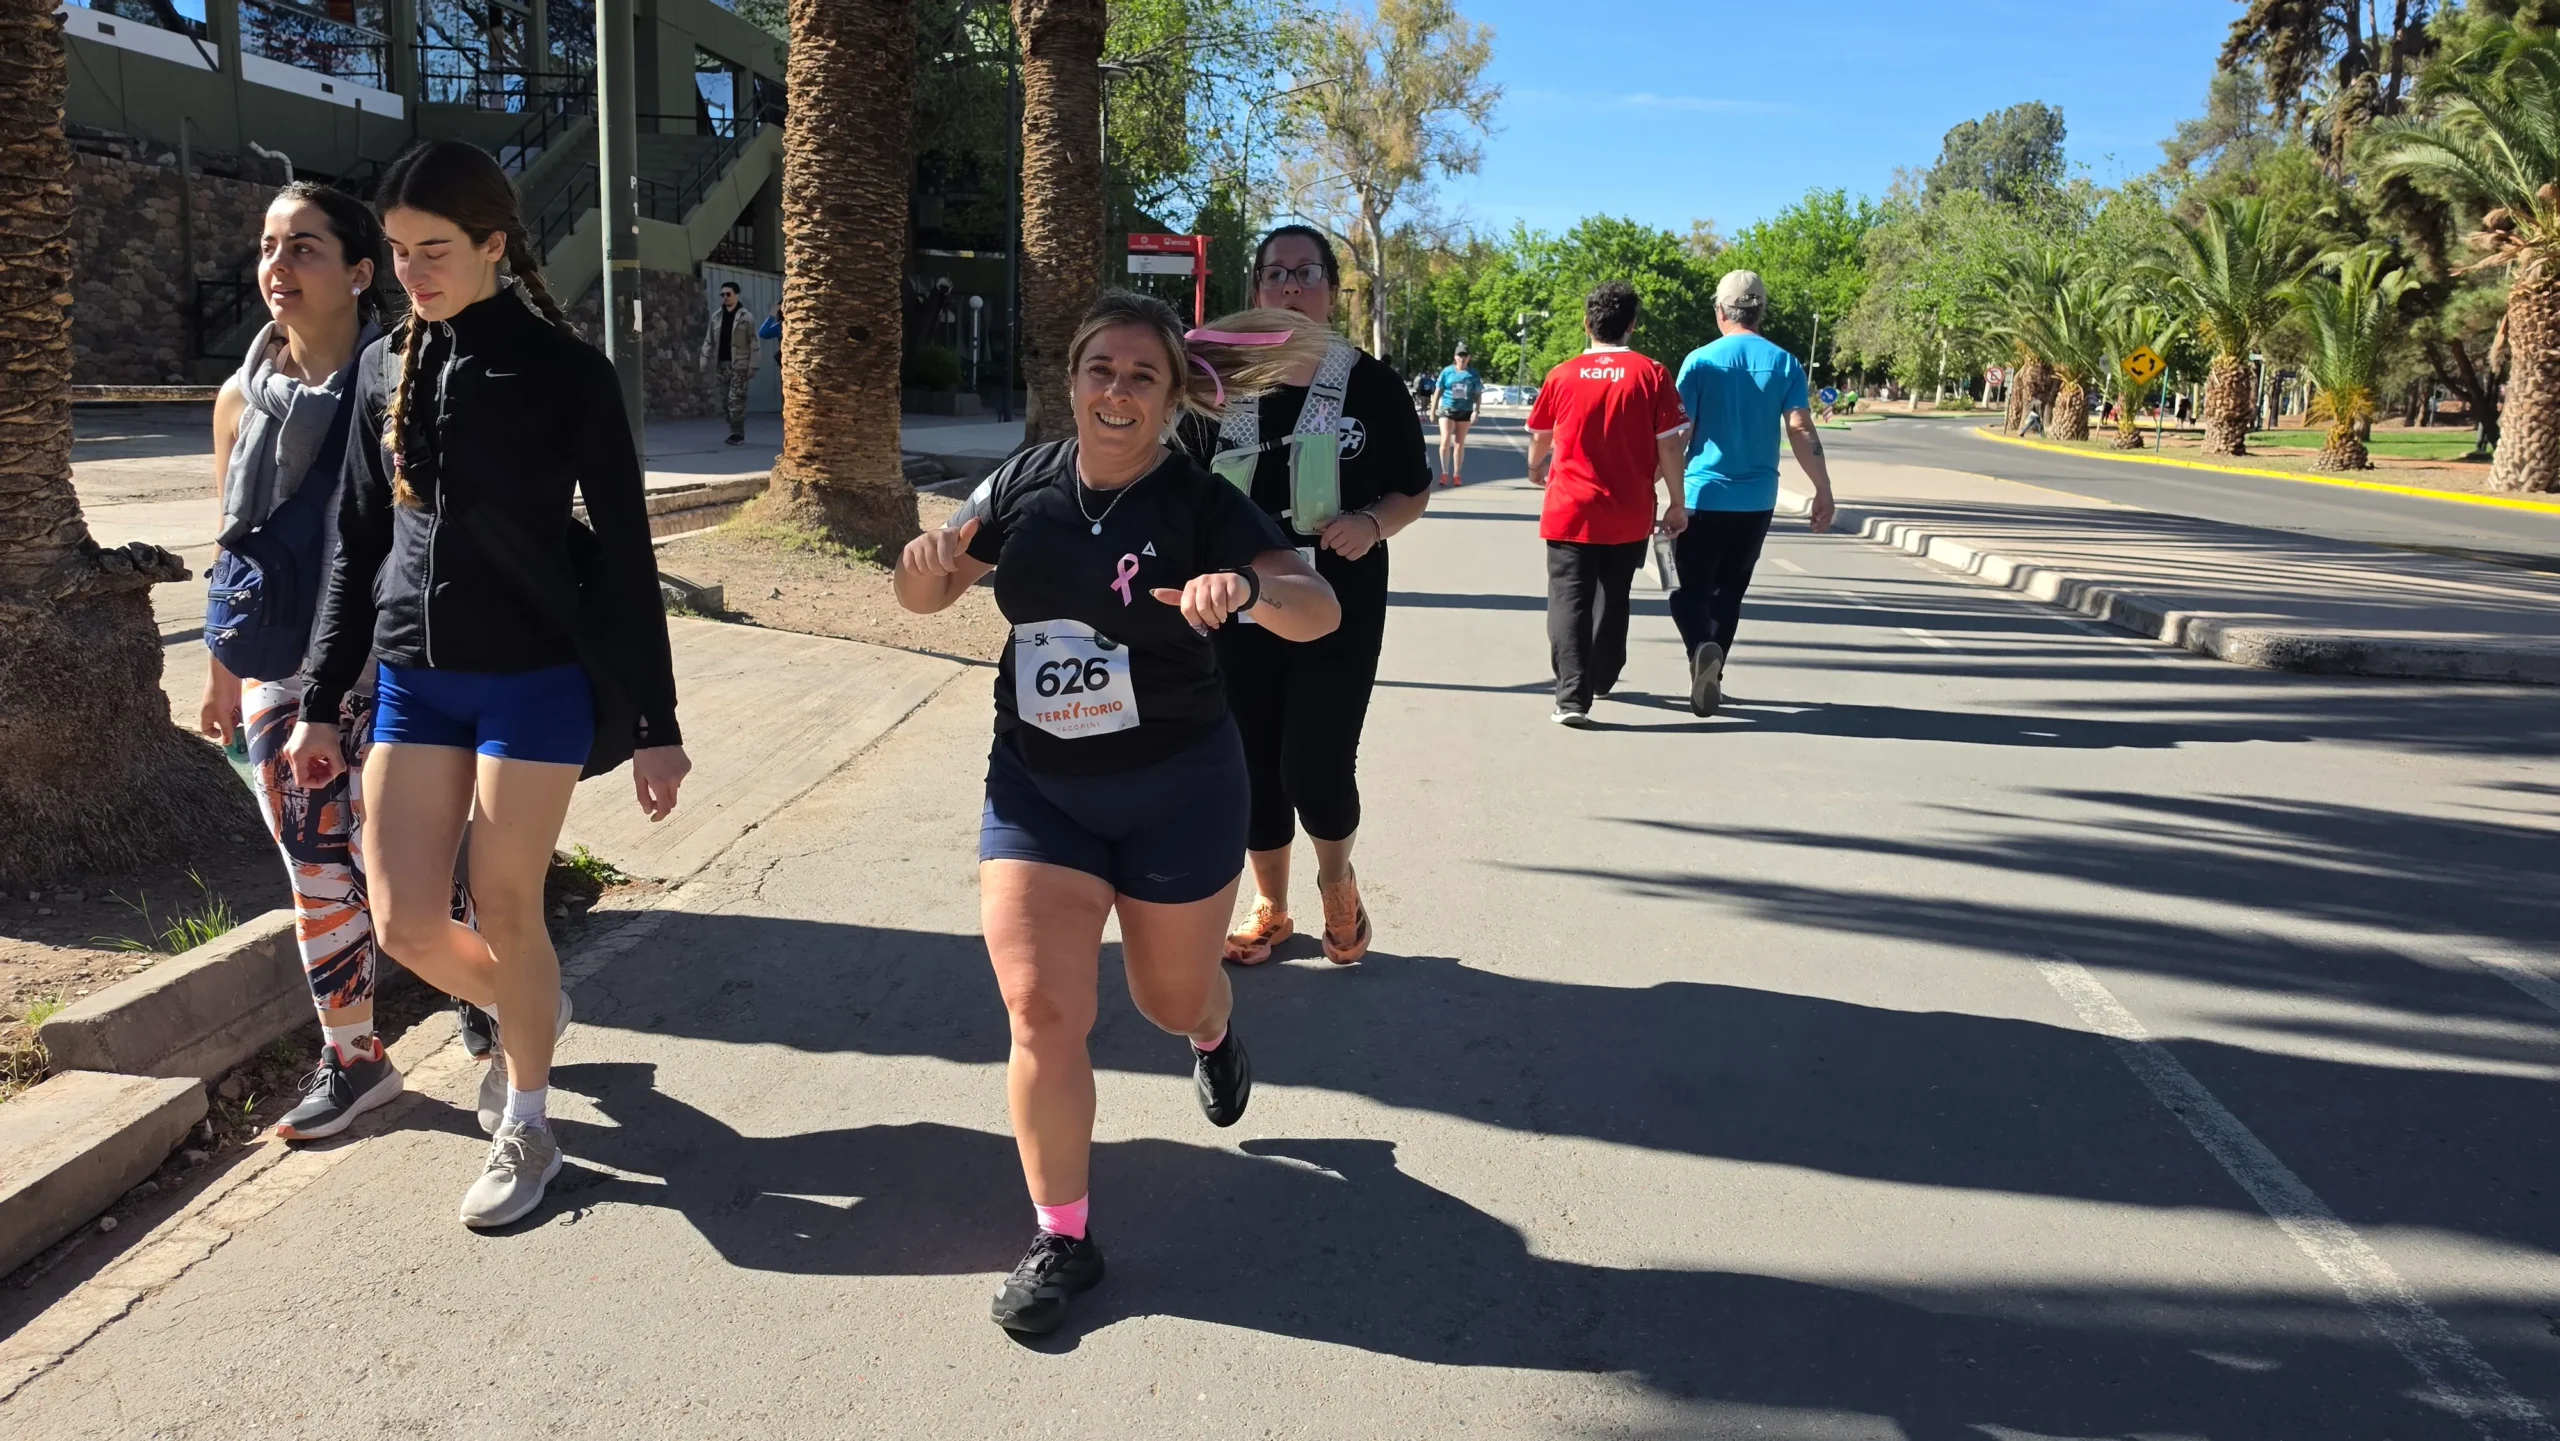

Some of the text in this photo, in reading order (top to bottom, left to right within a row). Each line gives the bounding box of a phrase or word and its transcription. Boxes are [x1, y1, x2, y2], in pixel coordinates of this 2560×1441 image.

[1035, 632, 1049, 647] 5k
[1035, 657, 1110, 698] 626
[1036, 700, 1123, 723] TERRITORIO
[1056, 721, 1100, 733] YACOPINI
